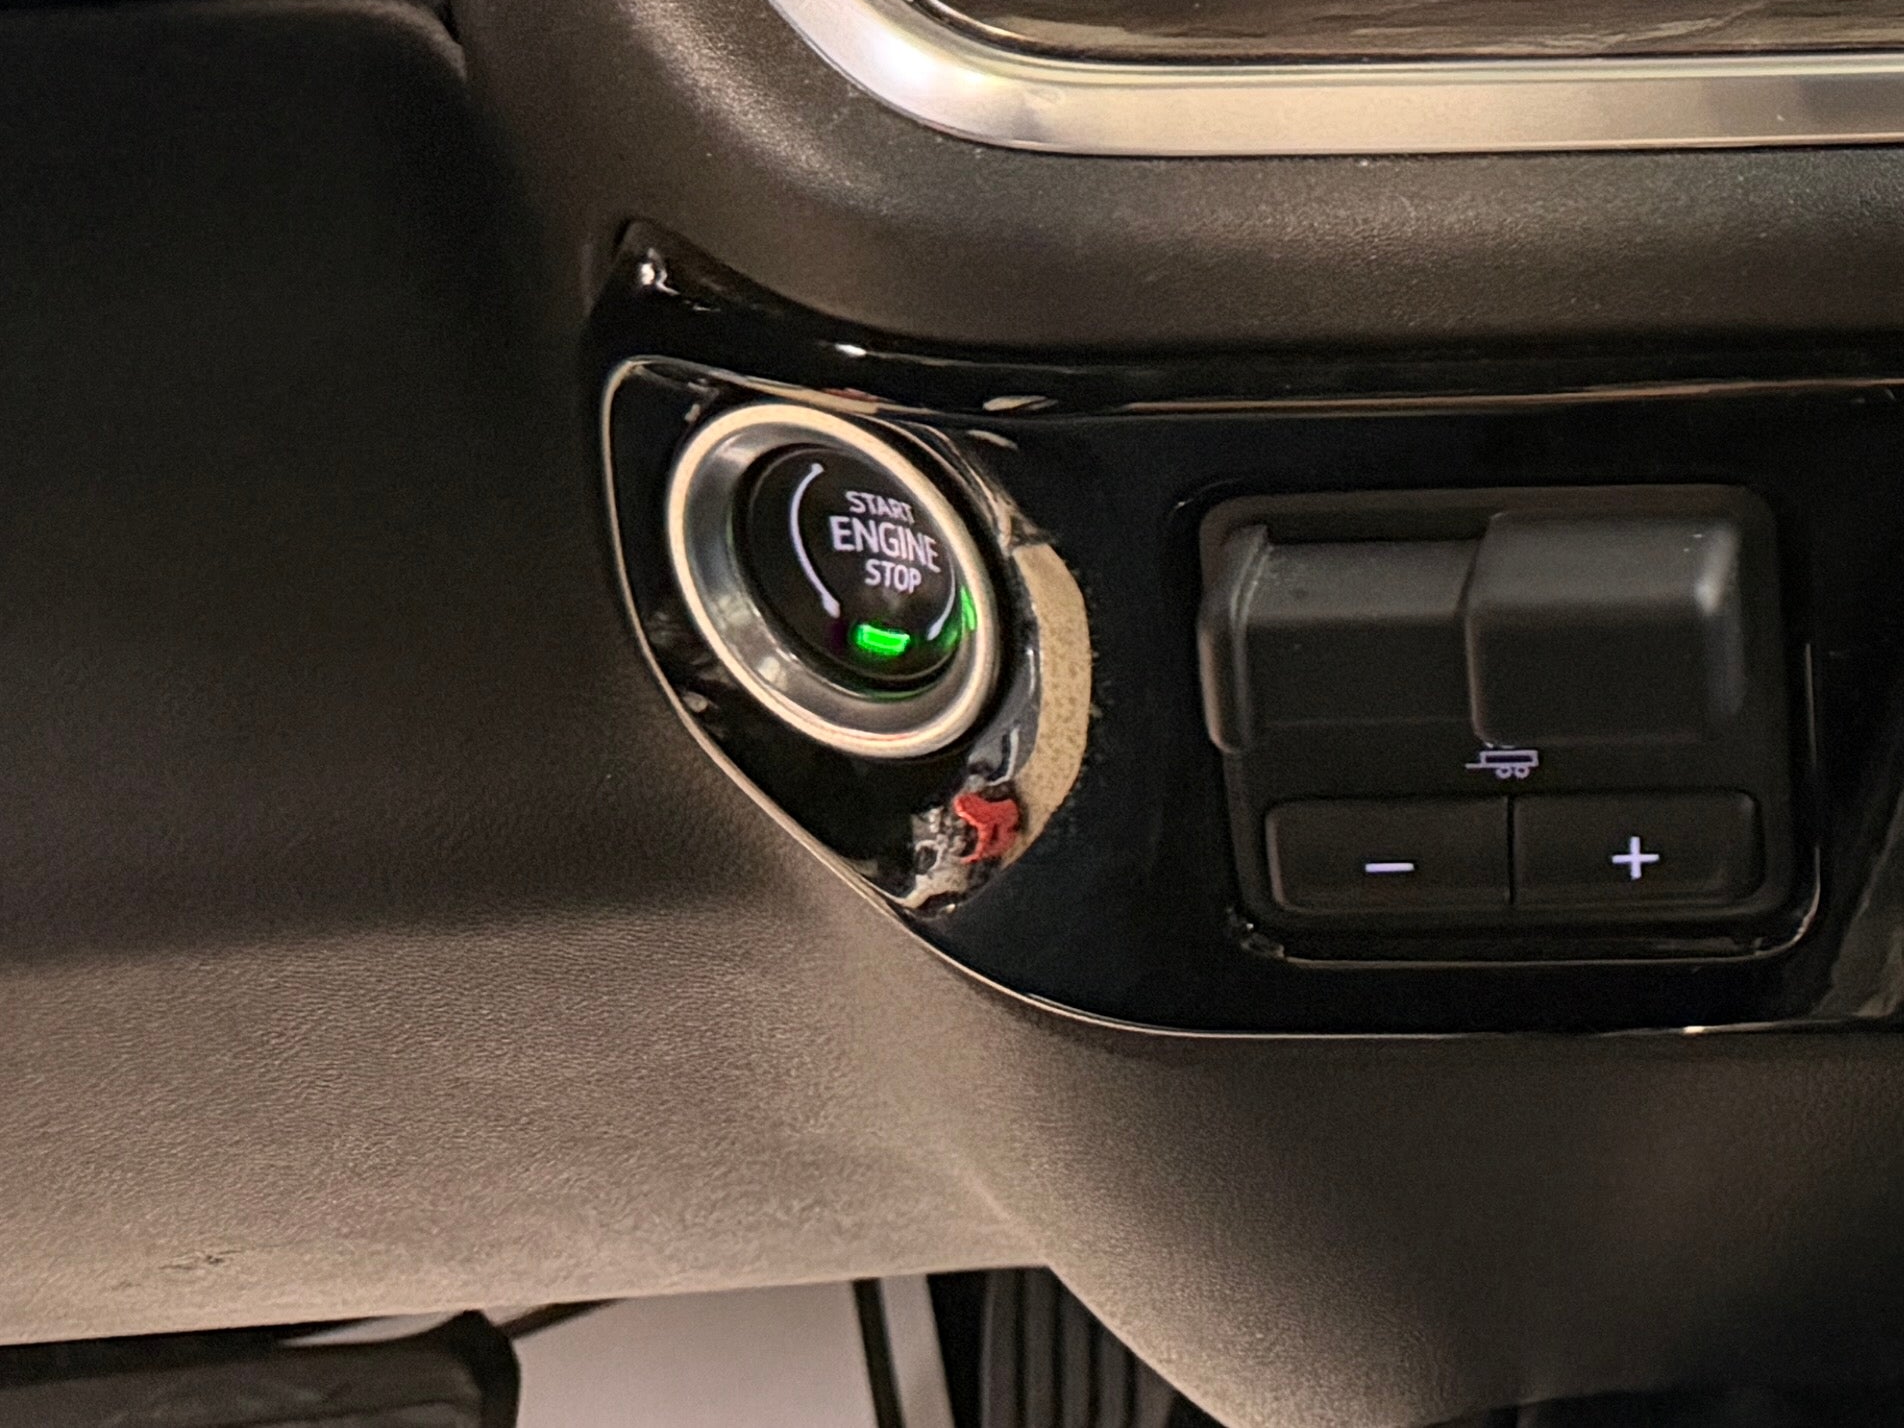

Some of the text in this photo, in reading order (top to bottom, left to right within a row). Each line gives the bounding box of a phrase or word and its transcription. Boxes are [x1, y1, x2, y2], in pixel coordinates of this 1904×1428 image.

[844, 490, 914, 525] START
[828, 514, 942, 574] ENGINE
[864, 558, 922, 593] STOP
